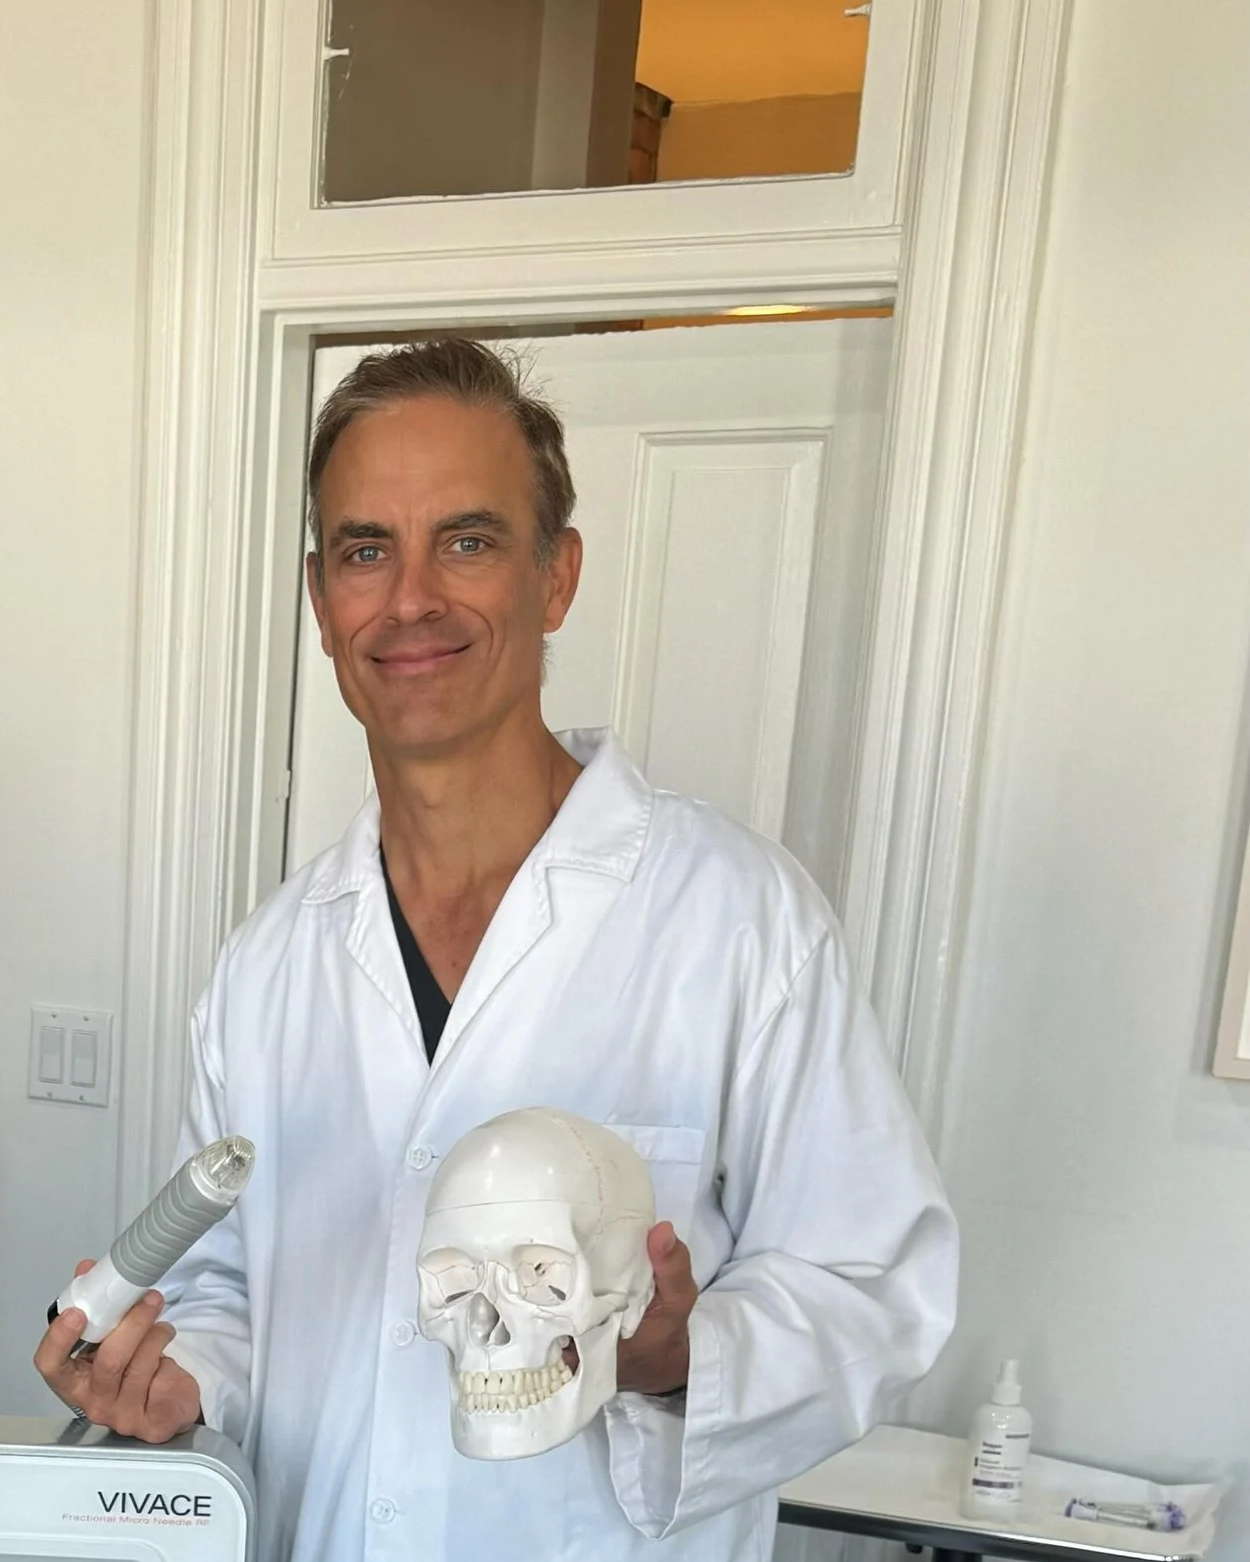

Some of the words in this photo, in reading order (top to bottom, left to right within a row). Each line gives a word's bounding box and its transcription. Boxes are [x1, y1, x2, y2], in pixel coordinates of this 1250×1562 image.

[97, 1491, 213, 1517] VIVACE
[62, 1512, 117, 1524] Fractional
[118, 1515, 150, 1525] Micro
[152, 1516, 192, 1526] Needle
